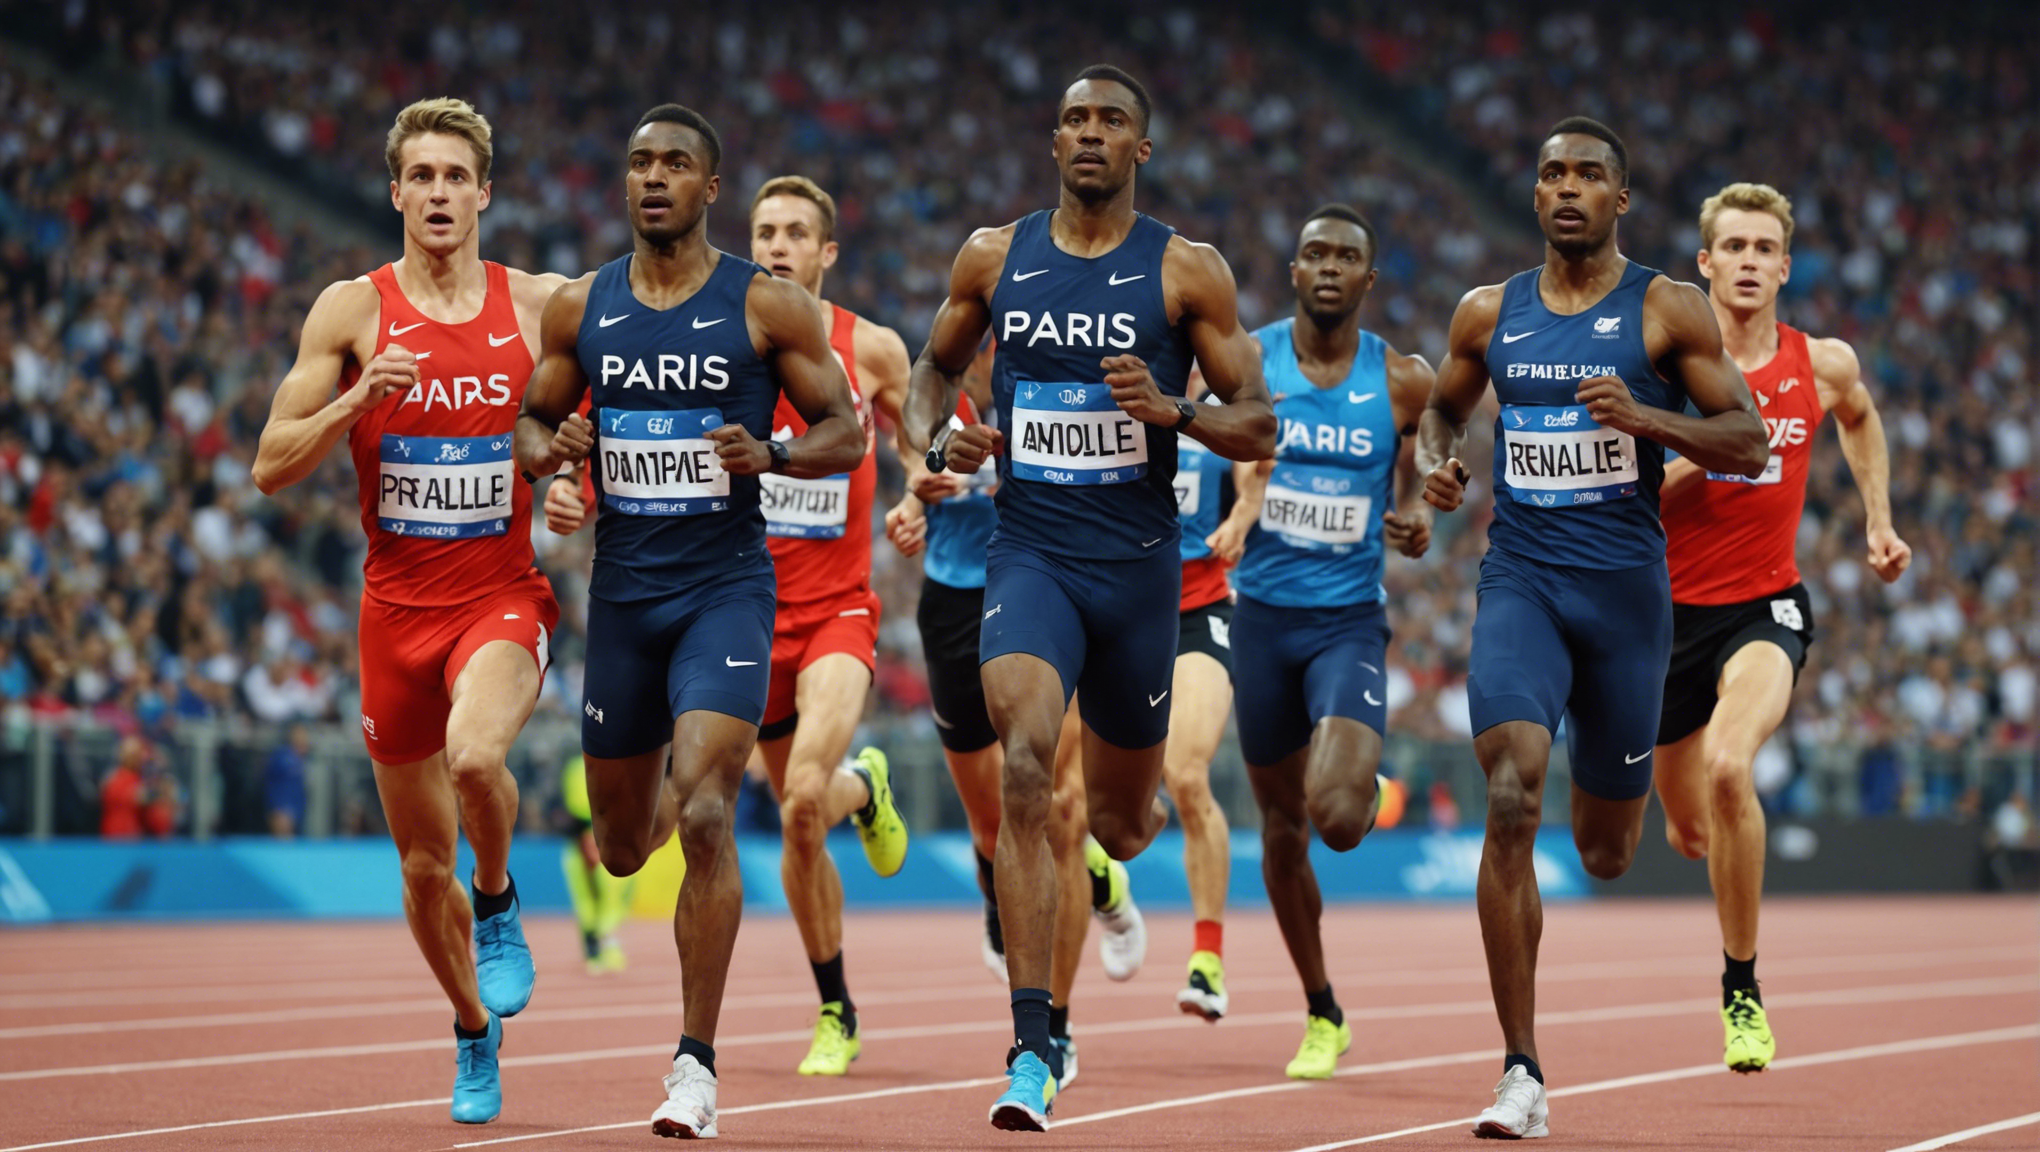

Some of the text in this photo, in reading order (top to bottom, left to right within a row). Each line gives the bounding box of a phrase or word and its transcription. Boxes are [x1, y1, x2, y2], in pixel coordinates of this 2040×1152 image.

[1003, 310, 1136, 349] PARIS
[601, 354, 730, 391] PARIS
[1509, 437, 1623, 477] RENALLE
